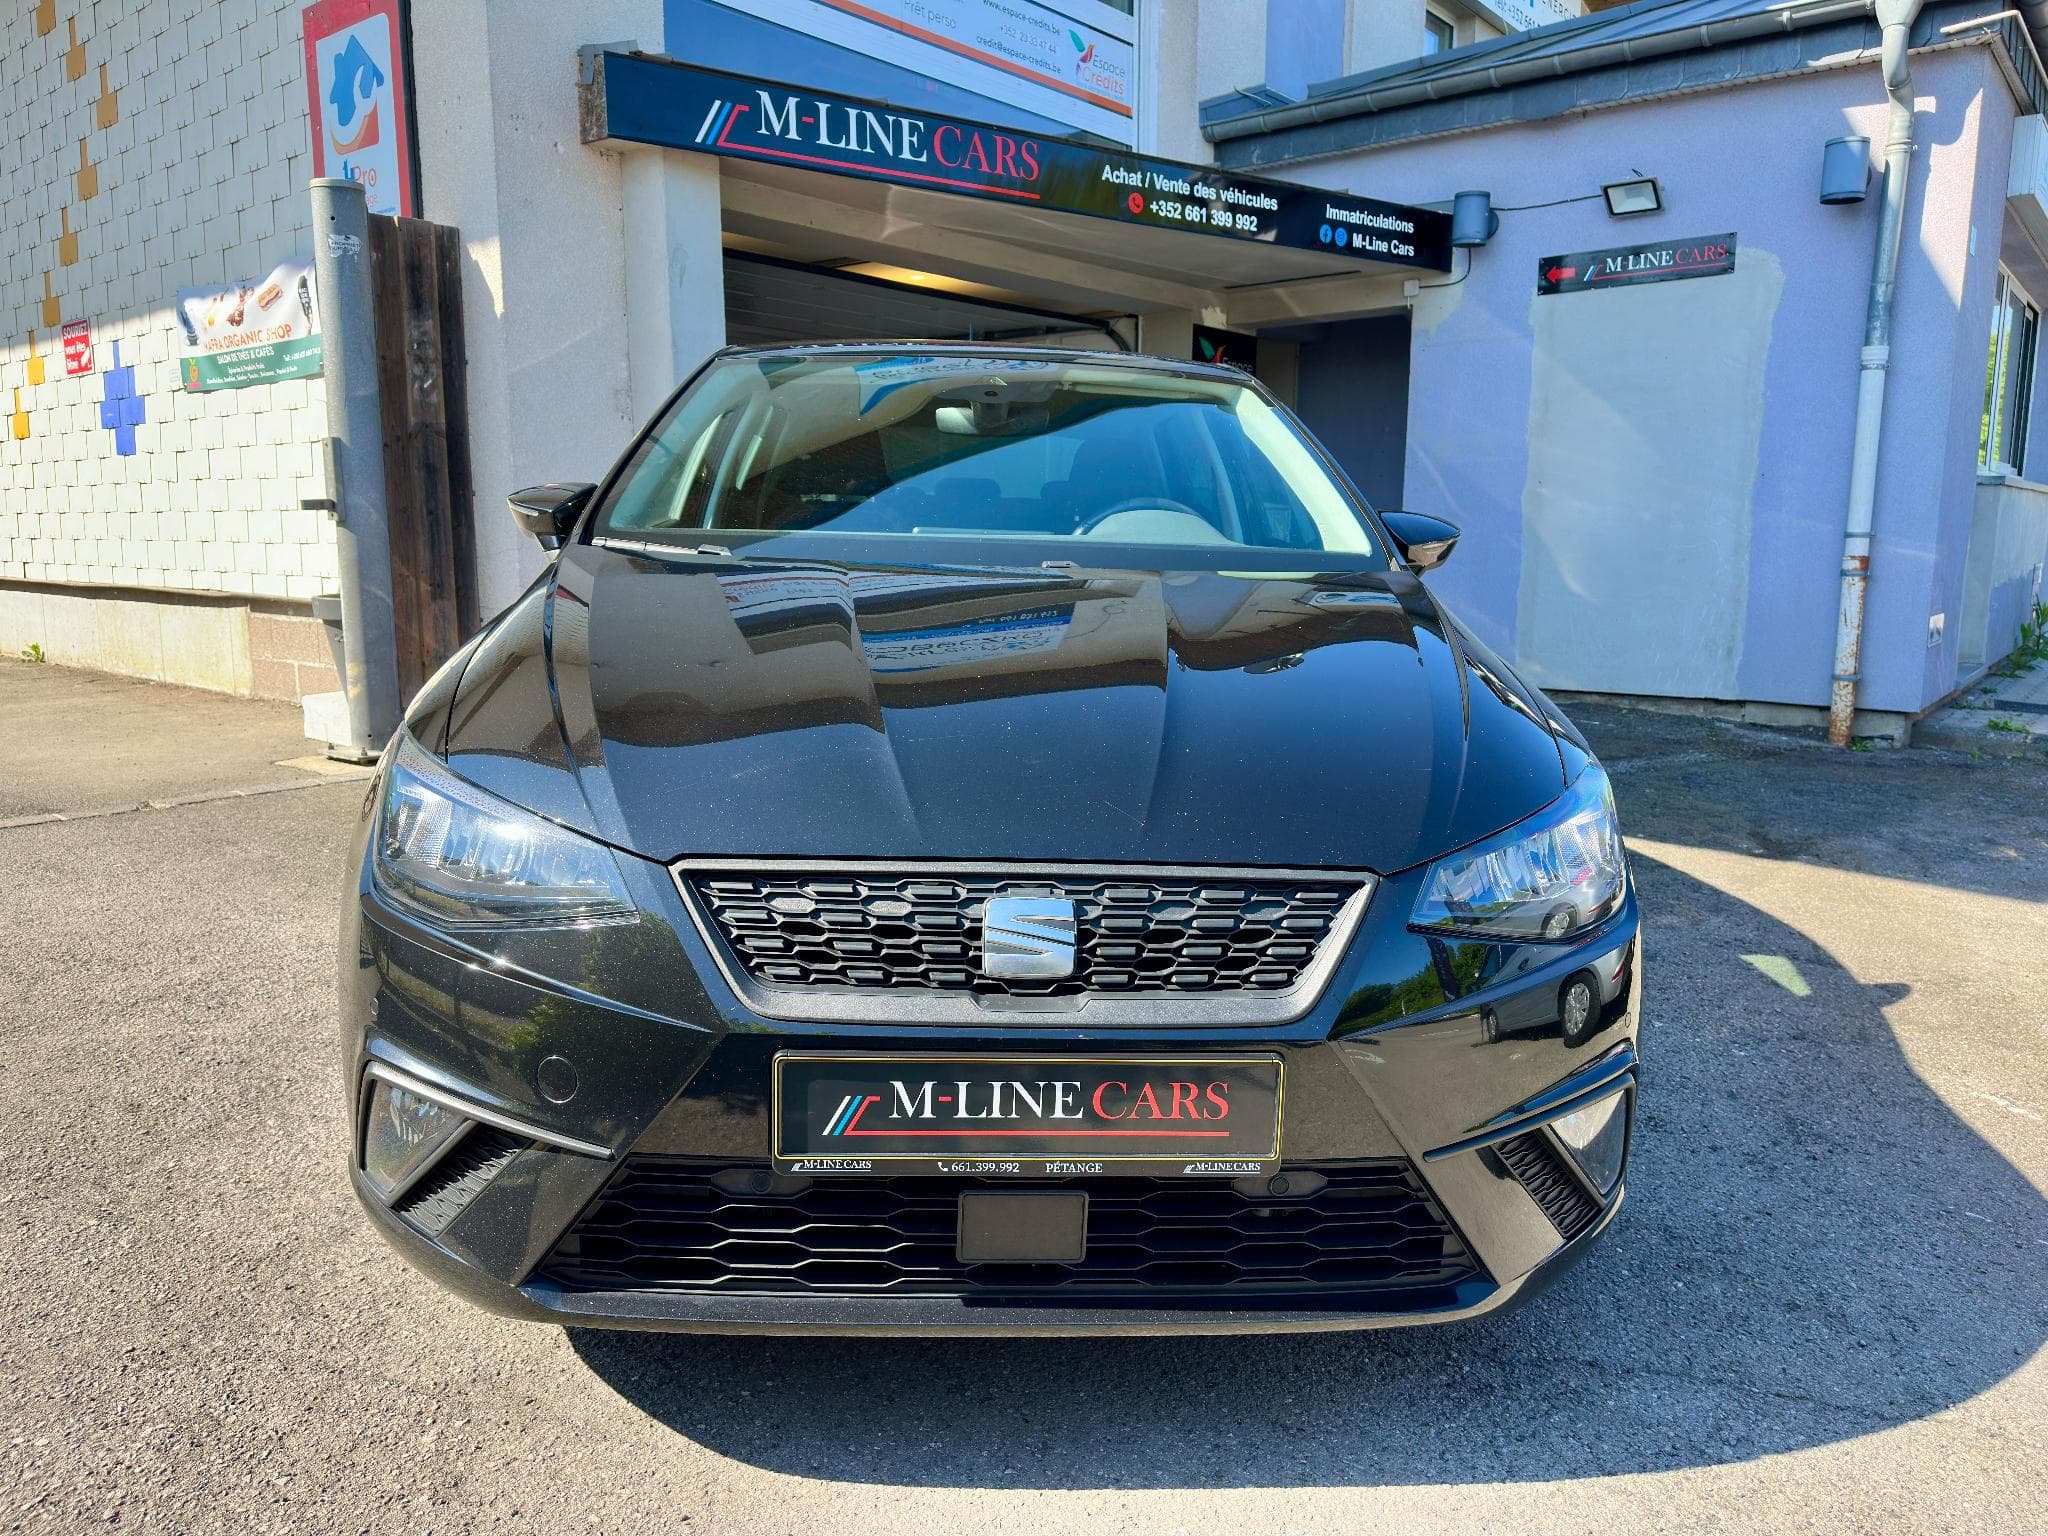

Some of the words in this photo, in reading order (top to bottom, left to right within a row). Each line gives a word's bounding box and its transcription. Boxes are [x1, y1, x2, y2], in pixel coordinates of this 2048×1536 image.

[927, 10, 957, 29] perso
[1092, 54, 1126, 78] Espace
[756, 90, 928, 163] M-LINE
[933, 125, 1042, 181] CARS
[1102, 165, 1143, 188] Achat
[1153, 173, 1191, 196] Vente
[1193, 181, 1217, 201] des
[1219, 187, 1278, 211] véhicules
[1150, 200, 1182, 220] +352
[1184, 205, 1207, 224] 661
[1210, 209, 1233, 228] 399
[1235, 213, 1258, 232] 992
[1325, 203, 1415, 234] Immatriculations
[1352, 232, 1389, 253] M-Line
[1390, 239, 1415, 257] Cars
[1605, 250, 1674, 273] M-LINE
[1675, 243, 1727, 264] CARS
[224, 330, 263, 348] ORGANIC
[266, 323, 292, 341] SHOP
[888, 1080, 1083, 1119] M-LINE
[1091, 1081, 1230, 1121] CARS
[803, 1159, 843, 1169] M-LINE
[843, 1159, 872, 1169] CARS
[951, 1161, 1020, 1173] 661.399.992
[1045, 1160, 1103, 1173] PÉTANGE
[1195, 1161, 1233, 1171] M-LINE
[1233, 1161, 1261, 1171] CARS
